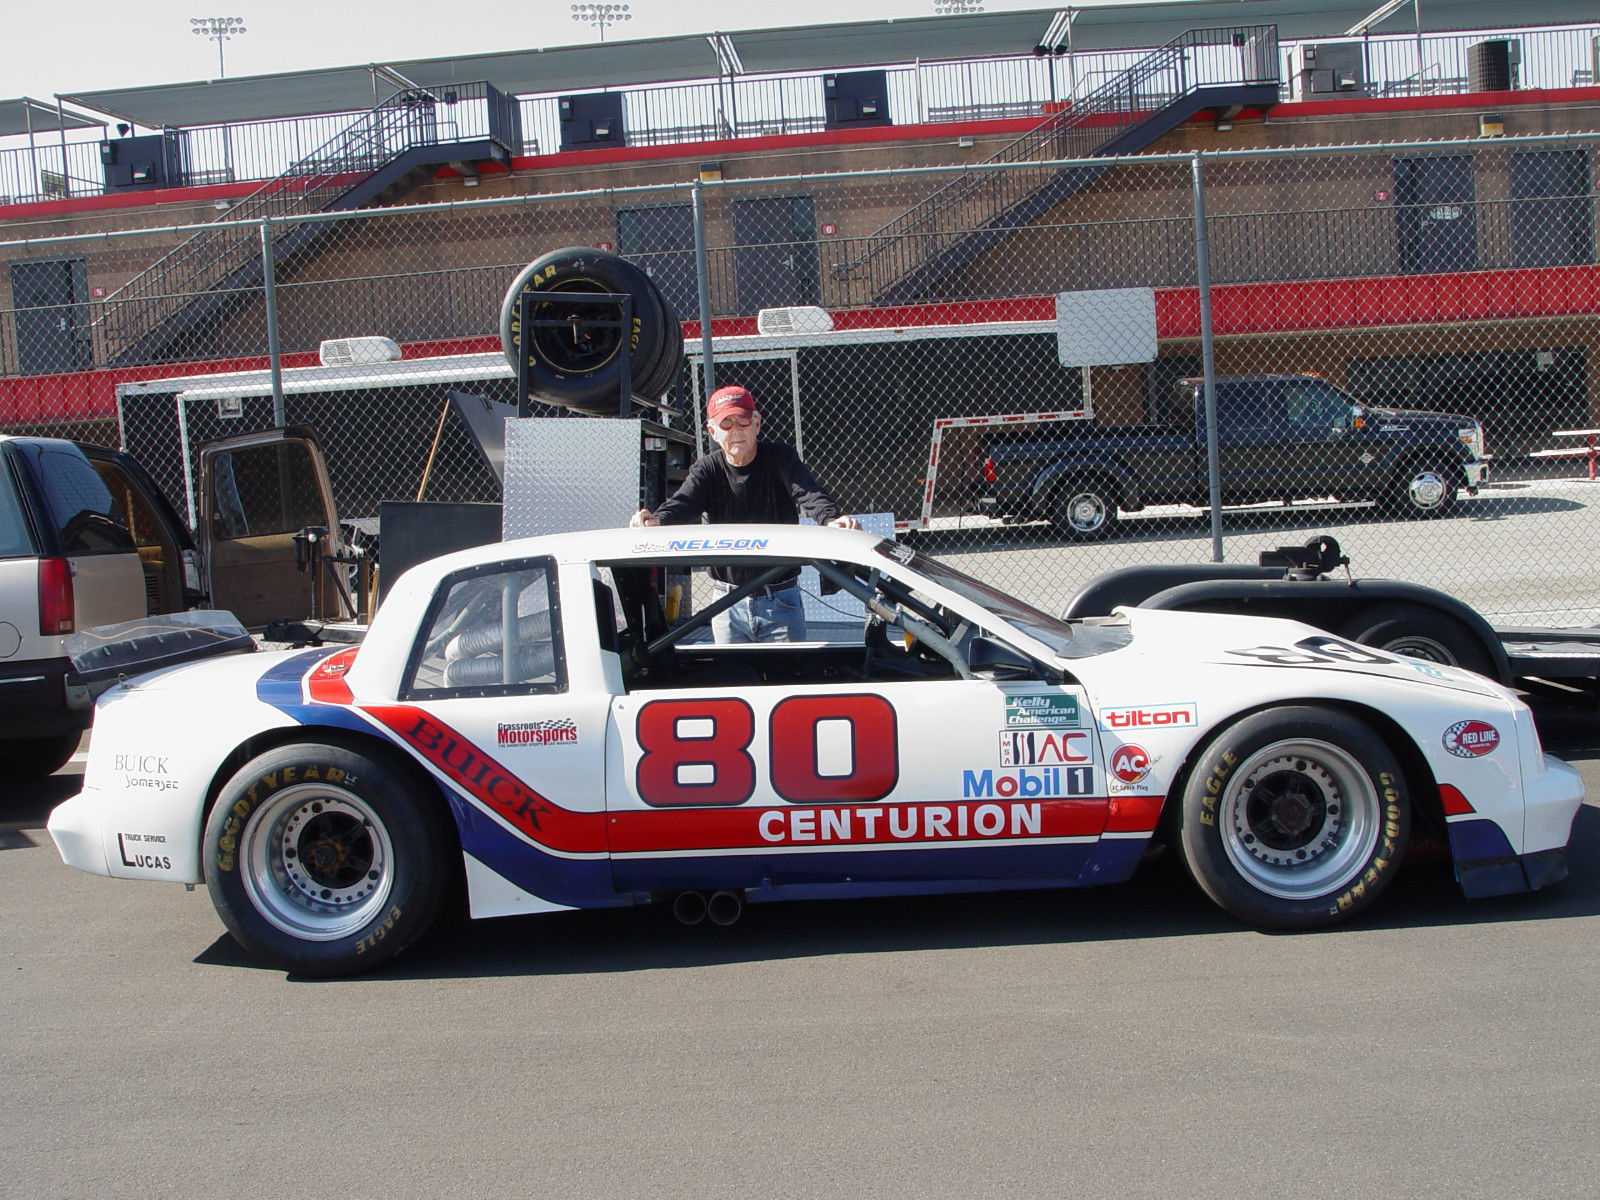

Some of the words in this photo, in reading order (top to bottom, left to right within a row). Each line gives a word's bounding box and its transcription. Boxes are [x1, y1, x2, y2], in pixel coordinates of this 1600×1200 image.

[668, 539, 769, 552] NELSON
[1012, 697, 1050, 708] Kelly
[1017, 705, 1076, 716] American
[497, 722, 541, 731] Grassroots
[1008, 715, 1067, 725] Challenge
[1106, 710, 1190, 727] tilton
[497, 727, 578, 745] Motorsports
[1462, 733, 1478, 744] RED
[1480, 730, 1497, 742] LINE
[635, 692, 899, 808] 80
[1002, 733, 1011, 765] IMSA
[115, 754, 169, 774] BUICK
[1115, 754, 1146, 773] AC
[406, 715, 553, 832] BUICK
[963, 768, 1060, 798] Mobil
[1200, 748, 1238, 827] EAGLE
[758, 803, 1042, 842] CENTURION
[125, 833, 142, 842] TRUCK
[143, 834, 168, 844] SERVICE
[1330, 771, 1401, 911] GOODYEAR
[117, 832, 172, 870] LUCAS
[355, 903, 403, 956] EAGLE
